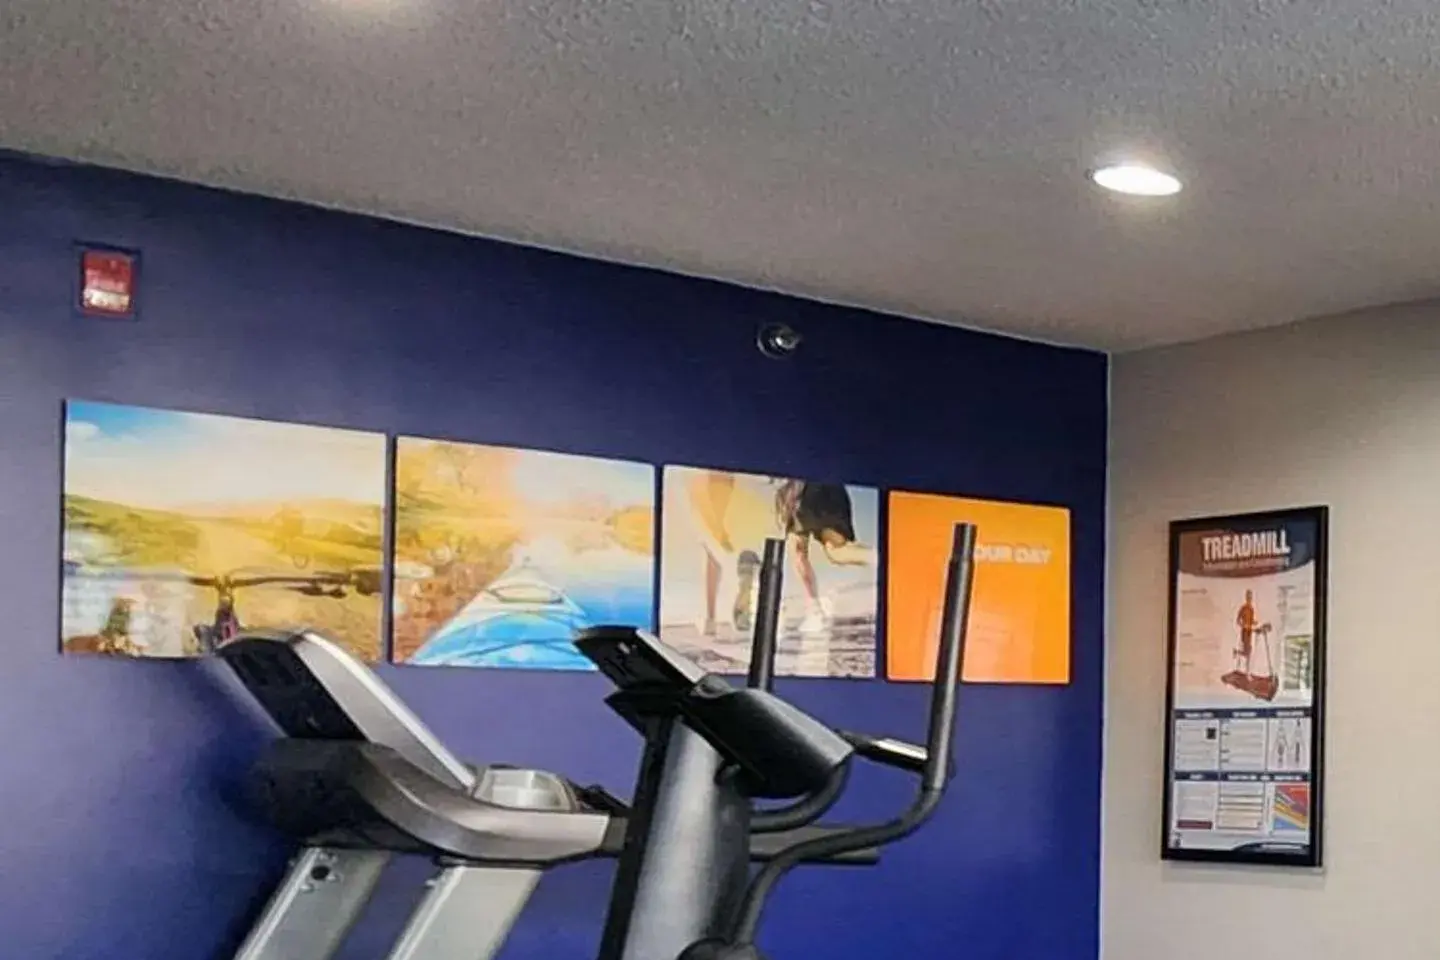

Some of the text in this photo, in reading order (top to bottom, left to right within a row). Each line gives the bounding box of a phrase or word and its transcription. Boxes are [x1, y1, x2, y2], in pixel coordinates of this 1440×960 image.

[973, 544, 1051, 565] OUR DAY
[1201, 529, 1291, 561] TREADMILL
